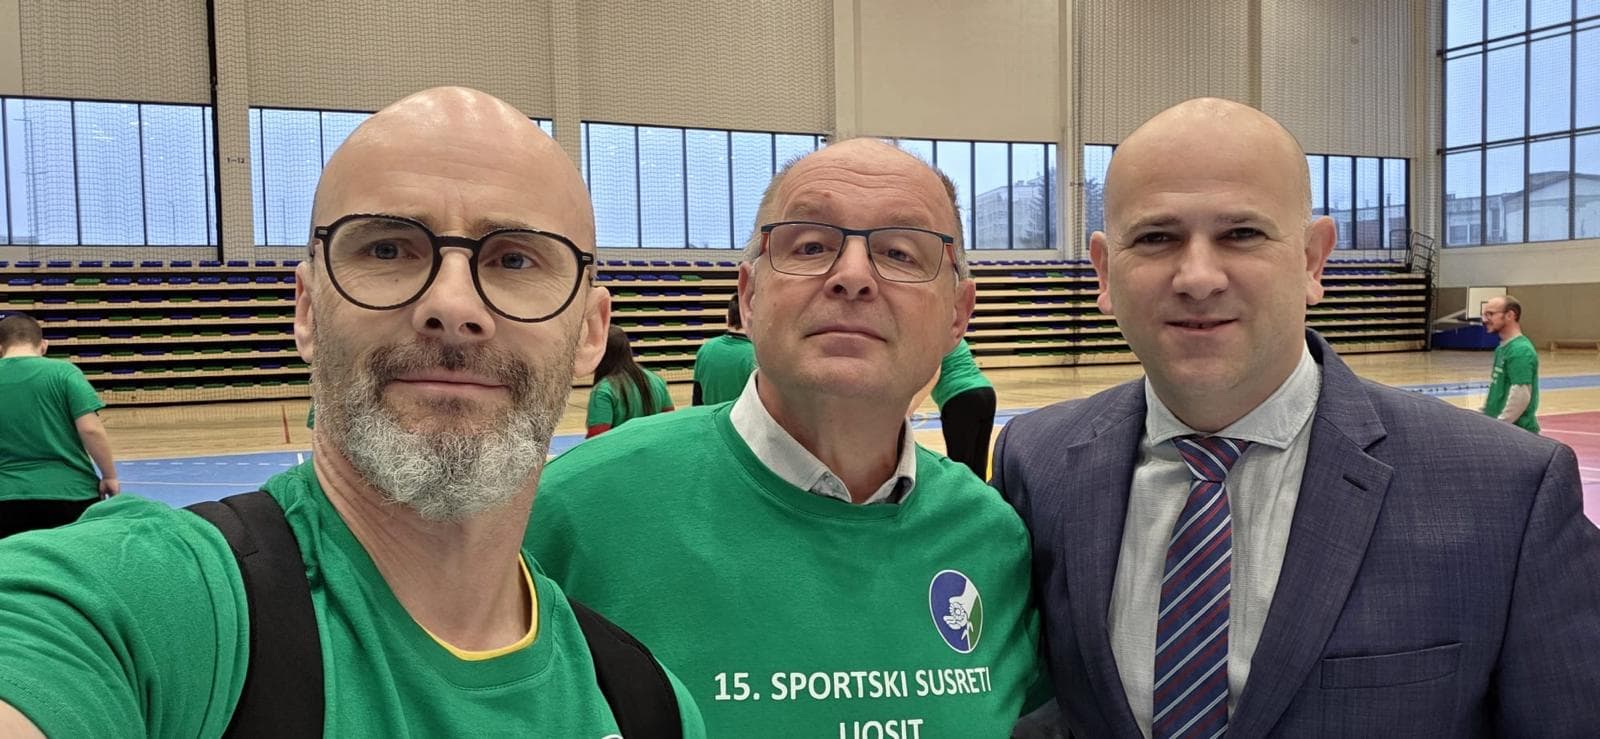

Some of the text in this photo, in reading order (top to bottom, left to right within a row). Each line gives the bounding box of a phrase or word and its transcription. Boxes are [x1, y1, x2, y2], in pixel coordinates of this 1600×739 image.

[714, 666, 992, 701] 15. SPORTSKI SUSRETI
